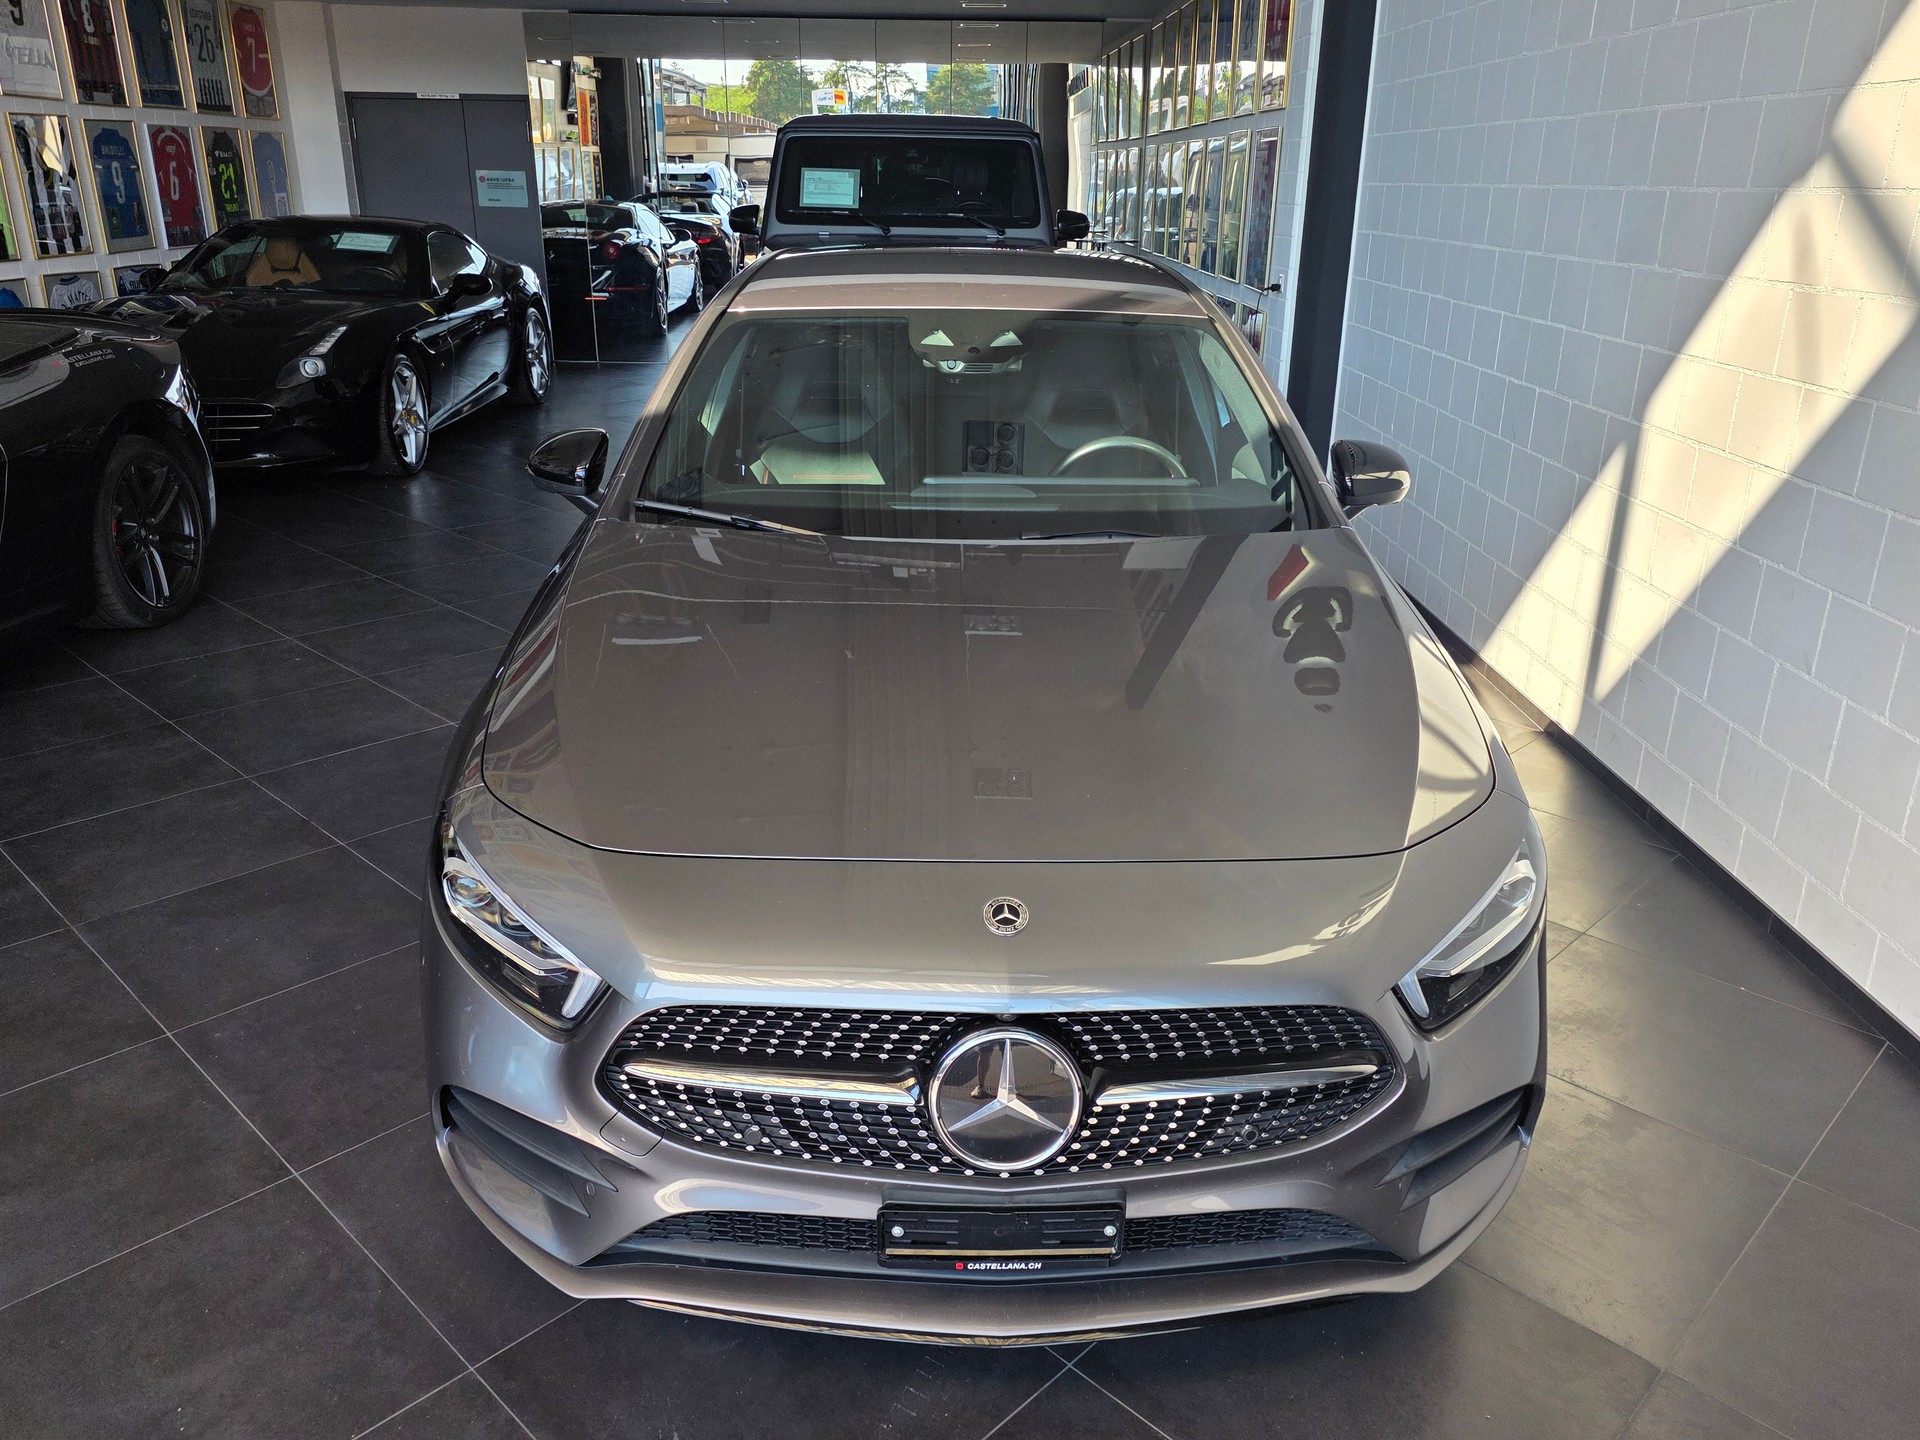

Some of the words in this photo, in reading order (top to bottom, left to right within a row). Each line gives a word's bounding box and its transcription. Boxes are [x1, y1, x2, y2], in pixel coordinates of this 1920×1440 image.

[111, 160, 125, 204] 9
[169, 161, 180, 201] 6
[67, 291, 92, 304] MATTE
[74, 356, 103, 368] EXCLUSIVE
[967, 1262, 1042, 1270] CASTELLANA.CH
